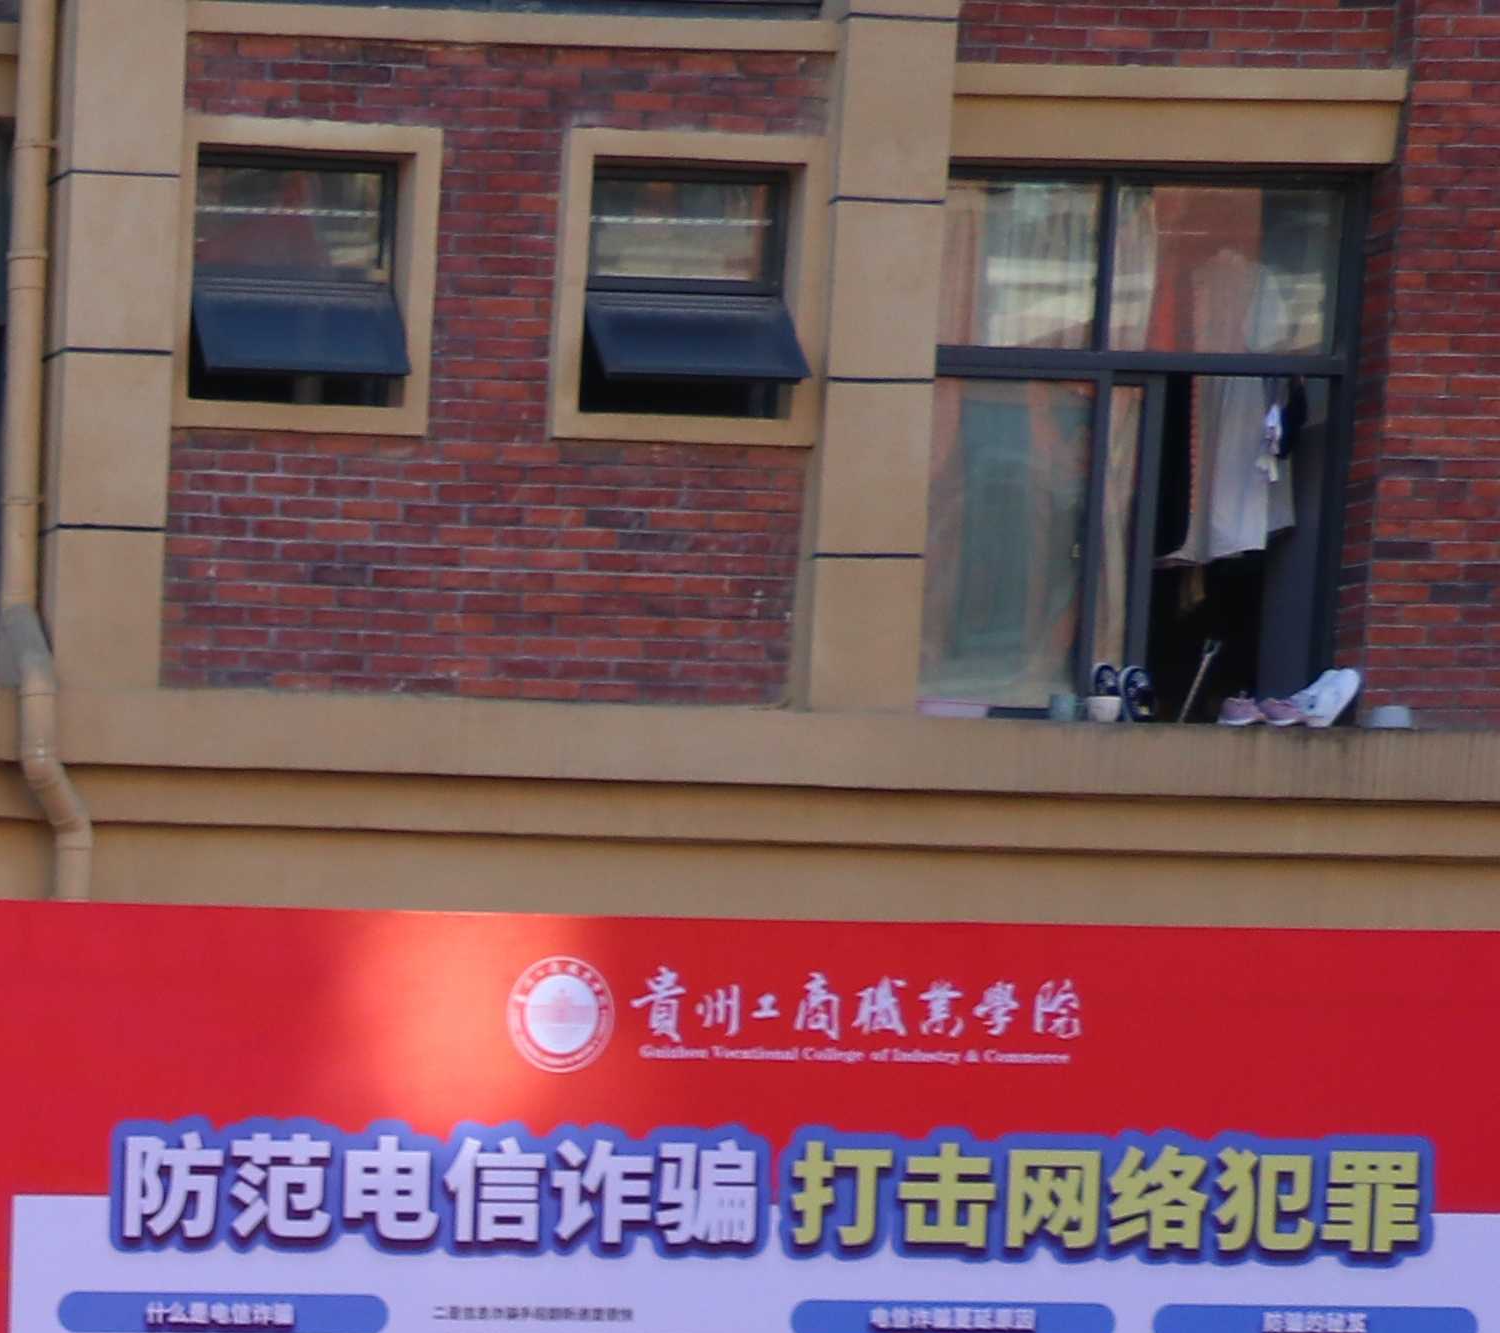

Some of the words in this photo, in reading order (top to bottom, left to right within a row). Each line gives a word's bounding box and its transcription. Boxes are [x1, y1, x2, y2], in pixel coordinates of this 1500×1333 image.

[121, 1134, 760, 1246] 防范电信诈骗
[790, 1141, 1422, 1254] 打击网络犯罪
[145, 1300, 295, 1326] 什么是电信诈骗
